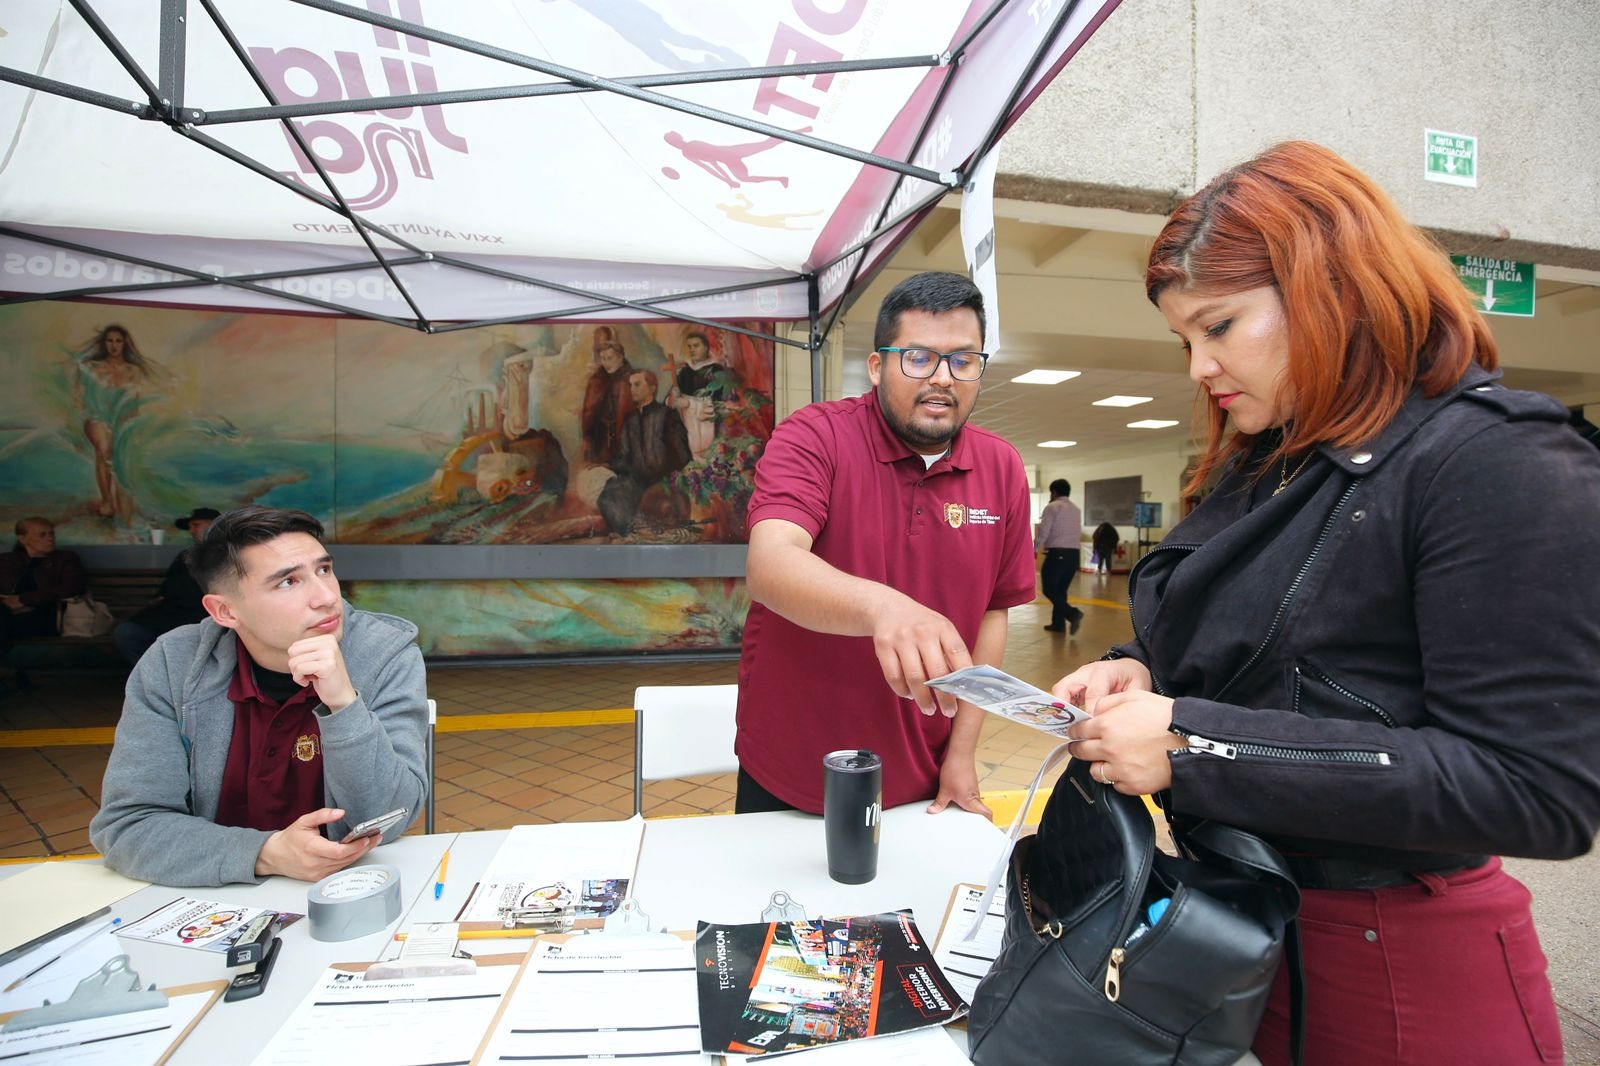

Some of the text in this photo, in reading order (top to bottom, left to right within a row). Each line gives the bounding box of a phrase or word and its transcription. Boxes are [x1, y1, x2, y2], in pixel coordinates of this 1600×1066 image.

[1435, 136, 1466, 149] RUTA DE
[1460, 266, 1523, 283] EMERGENCIA
[1466, 256, 1517, 271] SALIDA DE
[716, 930, 730, 991] TECNOVISION
[909, 973, 937, 1010] EXTERIOR
[914, 966, 952, 1011] ADVERTISING
